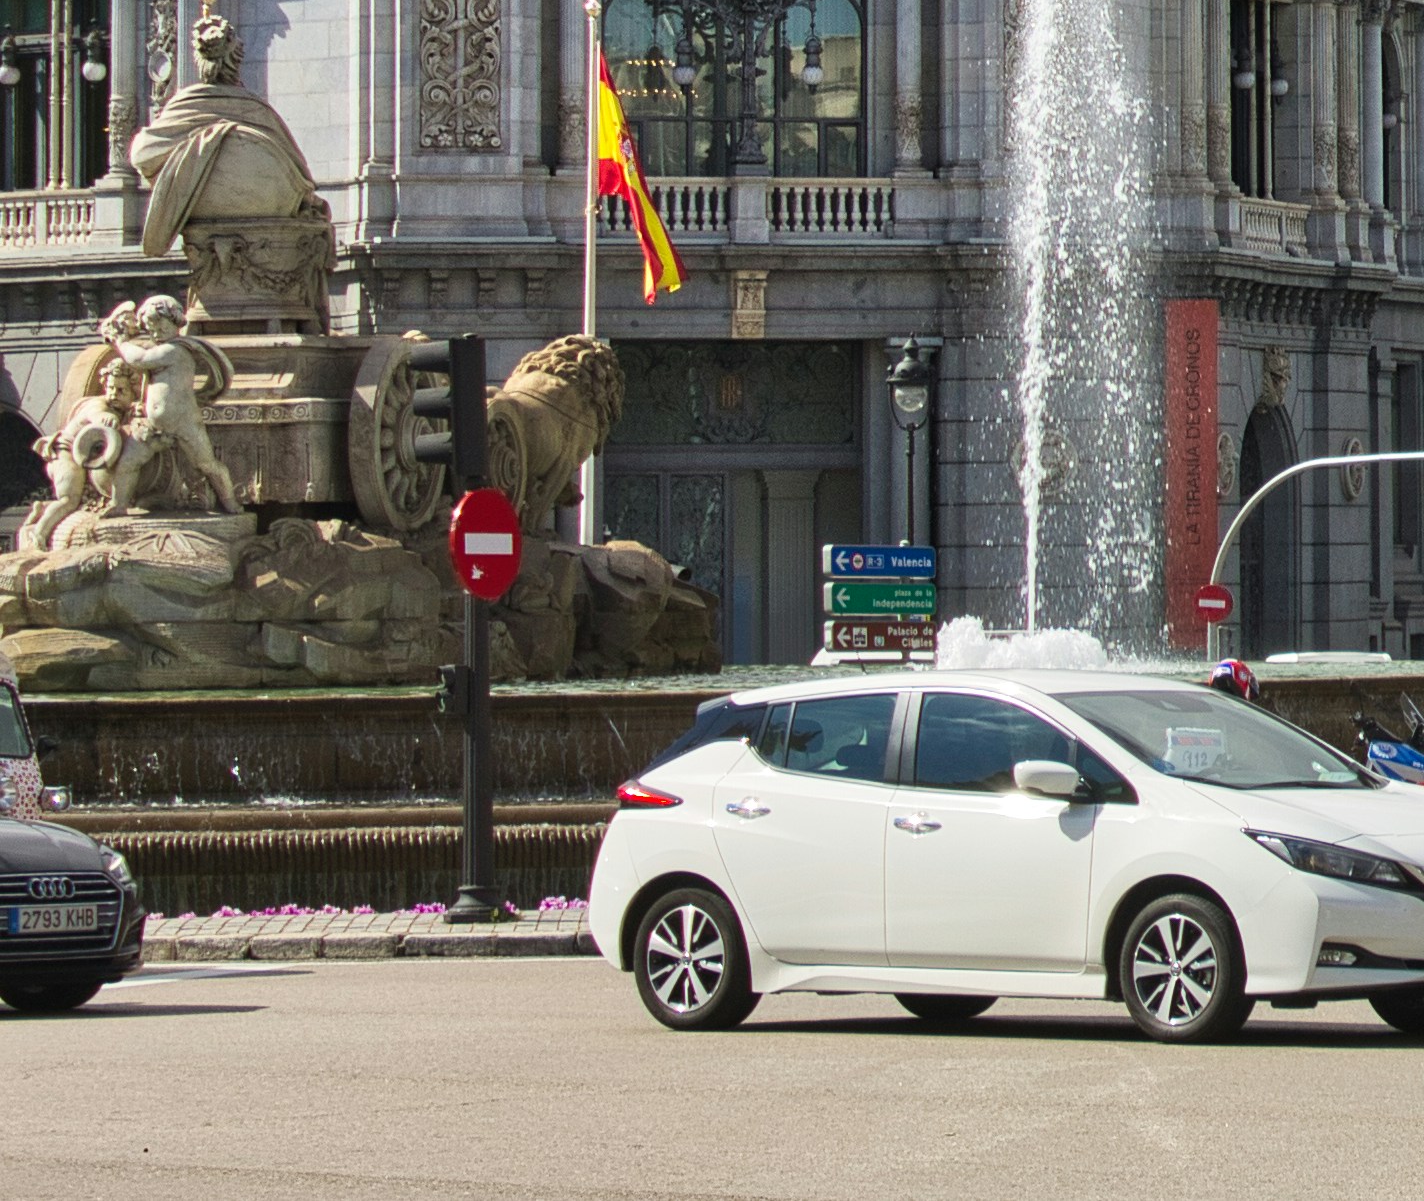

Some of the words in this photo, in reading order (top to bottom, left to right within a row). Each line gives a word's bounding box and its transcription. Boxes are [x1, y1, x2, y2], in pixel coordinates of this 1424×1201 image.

[1185, 329, 1200, 413] CRONOS
[1185, 417, 1200, 441] DE
[1185, 524, 1200, 546] LA
[891, 556, 932, 568] Valencia
[895, 589, 911, 597] plaza
[873, 599, 932, 610] Independencia
[887, 626, 918, 636] Palacio
[923, 626, 933, 636] de
[22, 909, 61, 929] 2793
[66, 908, 94, 927] KHB
